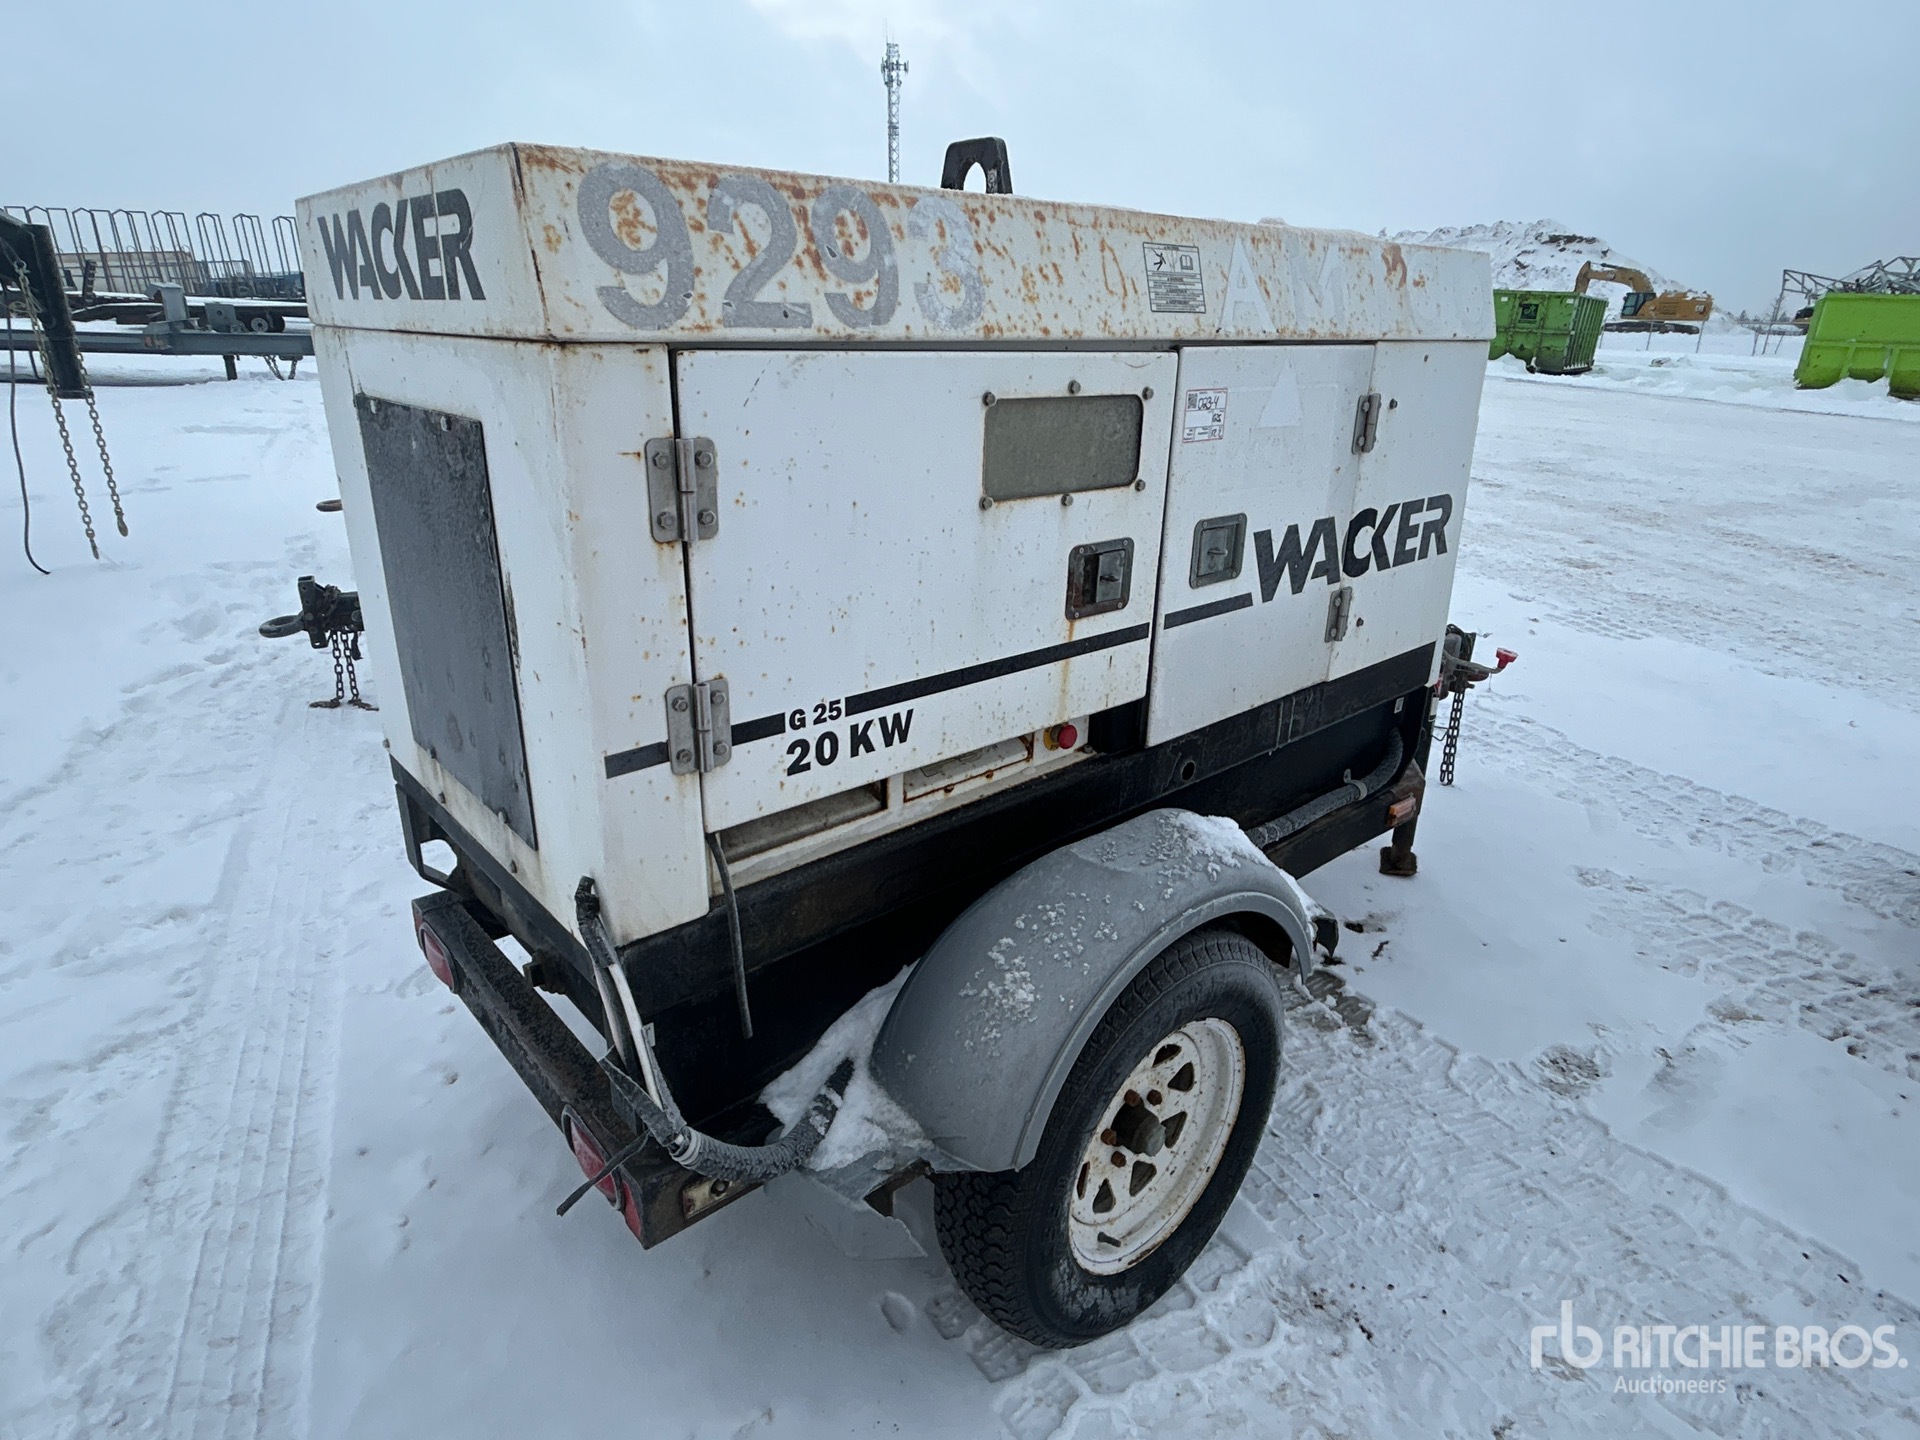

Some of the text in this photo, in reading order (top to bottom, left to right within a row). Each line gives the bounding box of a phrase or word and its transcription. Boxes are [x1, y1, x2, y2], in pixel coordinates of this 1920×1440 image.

[317, 187, 487, 301] WACKER
[577, 162, 985, 331] 9293
[1253, 493, 1453, 604] WACKER
[785, 707, 914, 777] 20 KW
[788, 698, 842, 731] G 25
